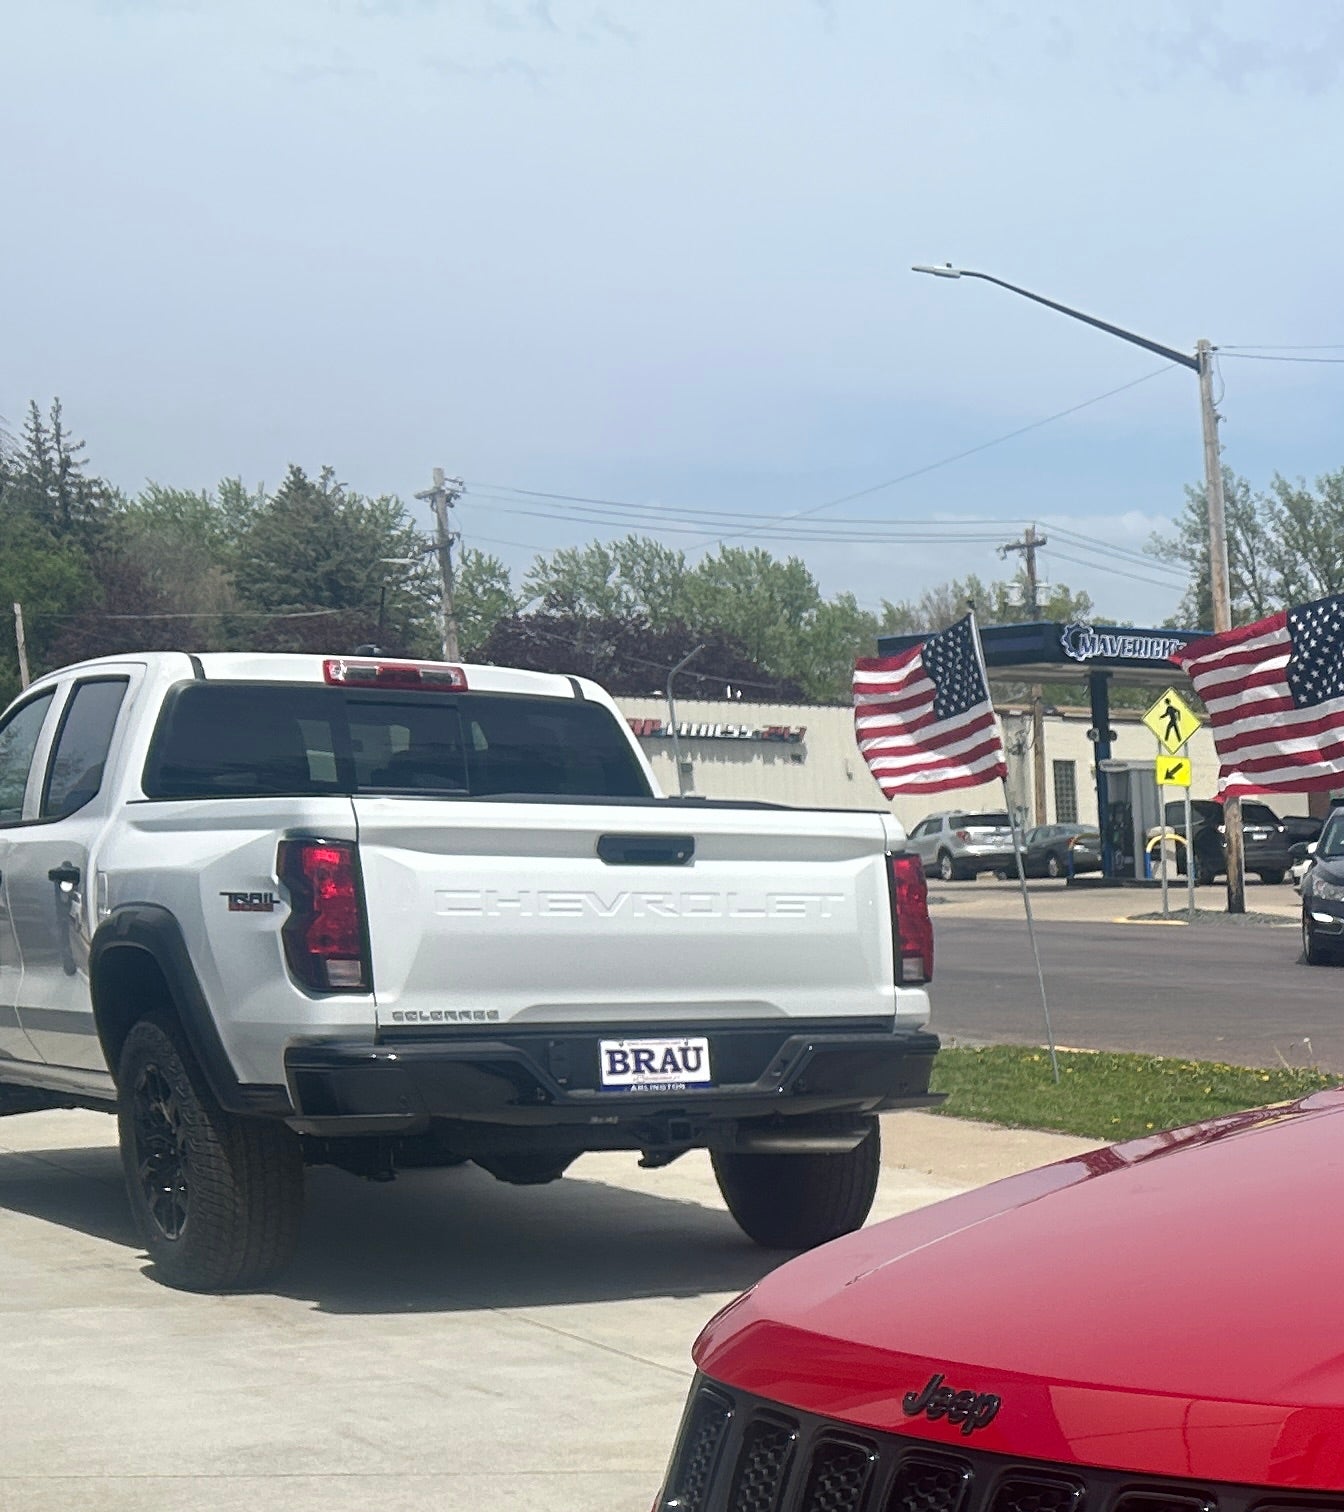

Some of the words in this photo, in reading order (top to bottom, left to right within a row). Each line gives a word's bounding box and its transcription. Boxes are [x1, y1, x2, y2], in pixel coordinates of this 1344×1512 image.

[219, 892, 280, 904] TRAIL
[434, 889, 844, 918] CHEVROLET
[392, 1009, 499, 1021] COLORADO
[605, 1046, 703, 1075] BRAU
[903, 1374, 1001, 1436] Jeep
